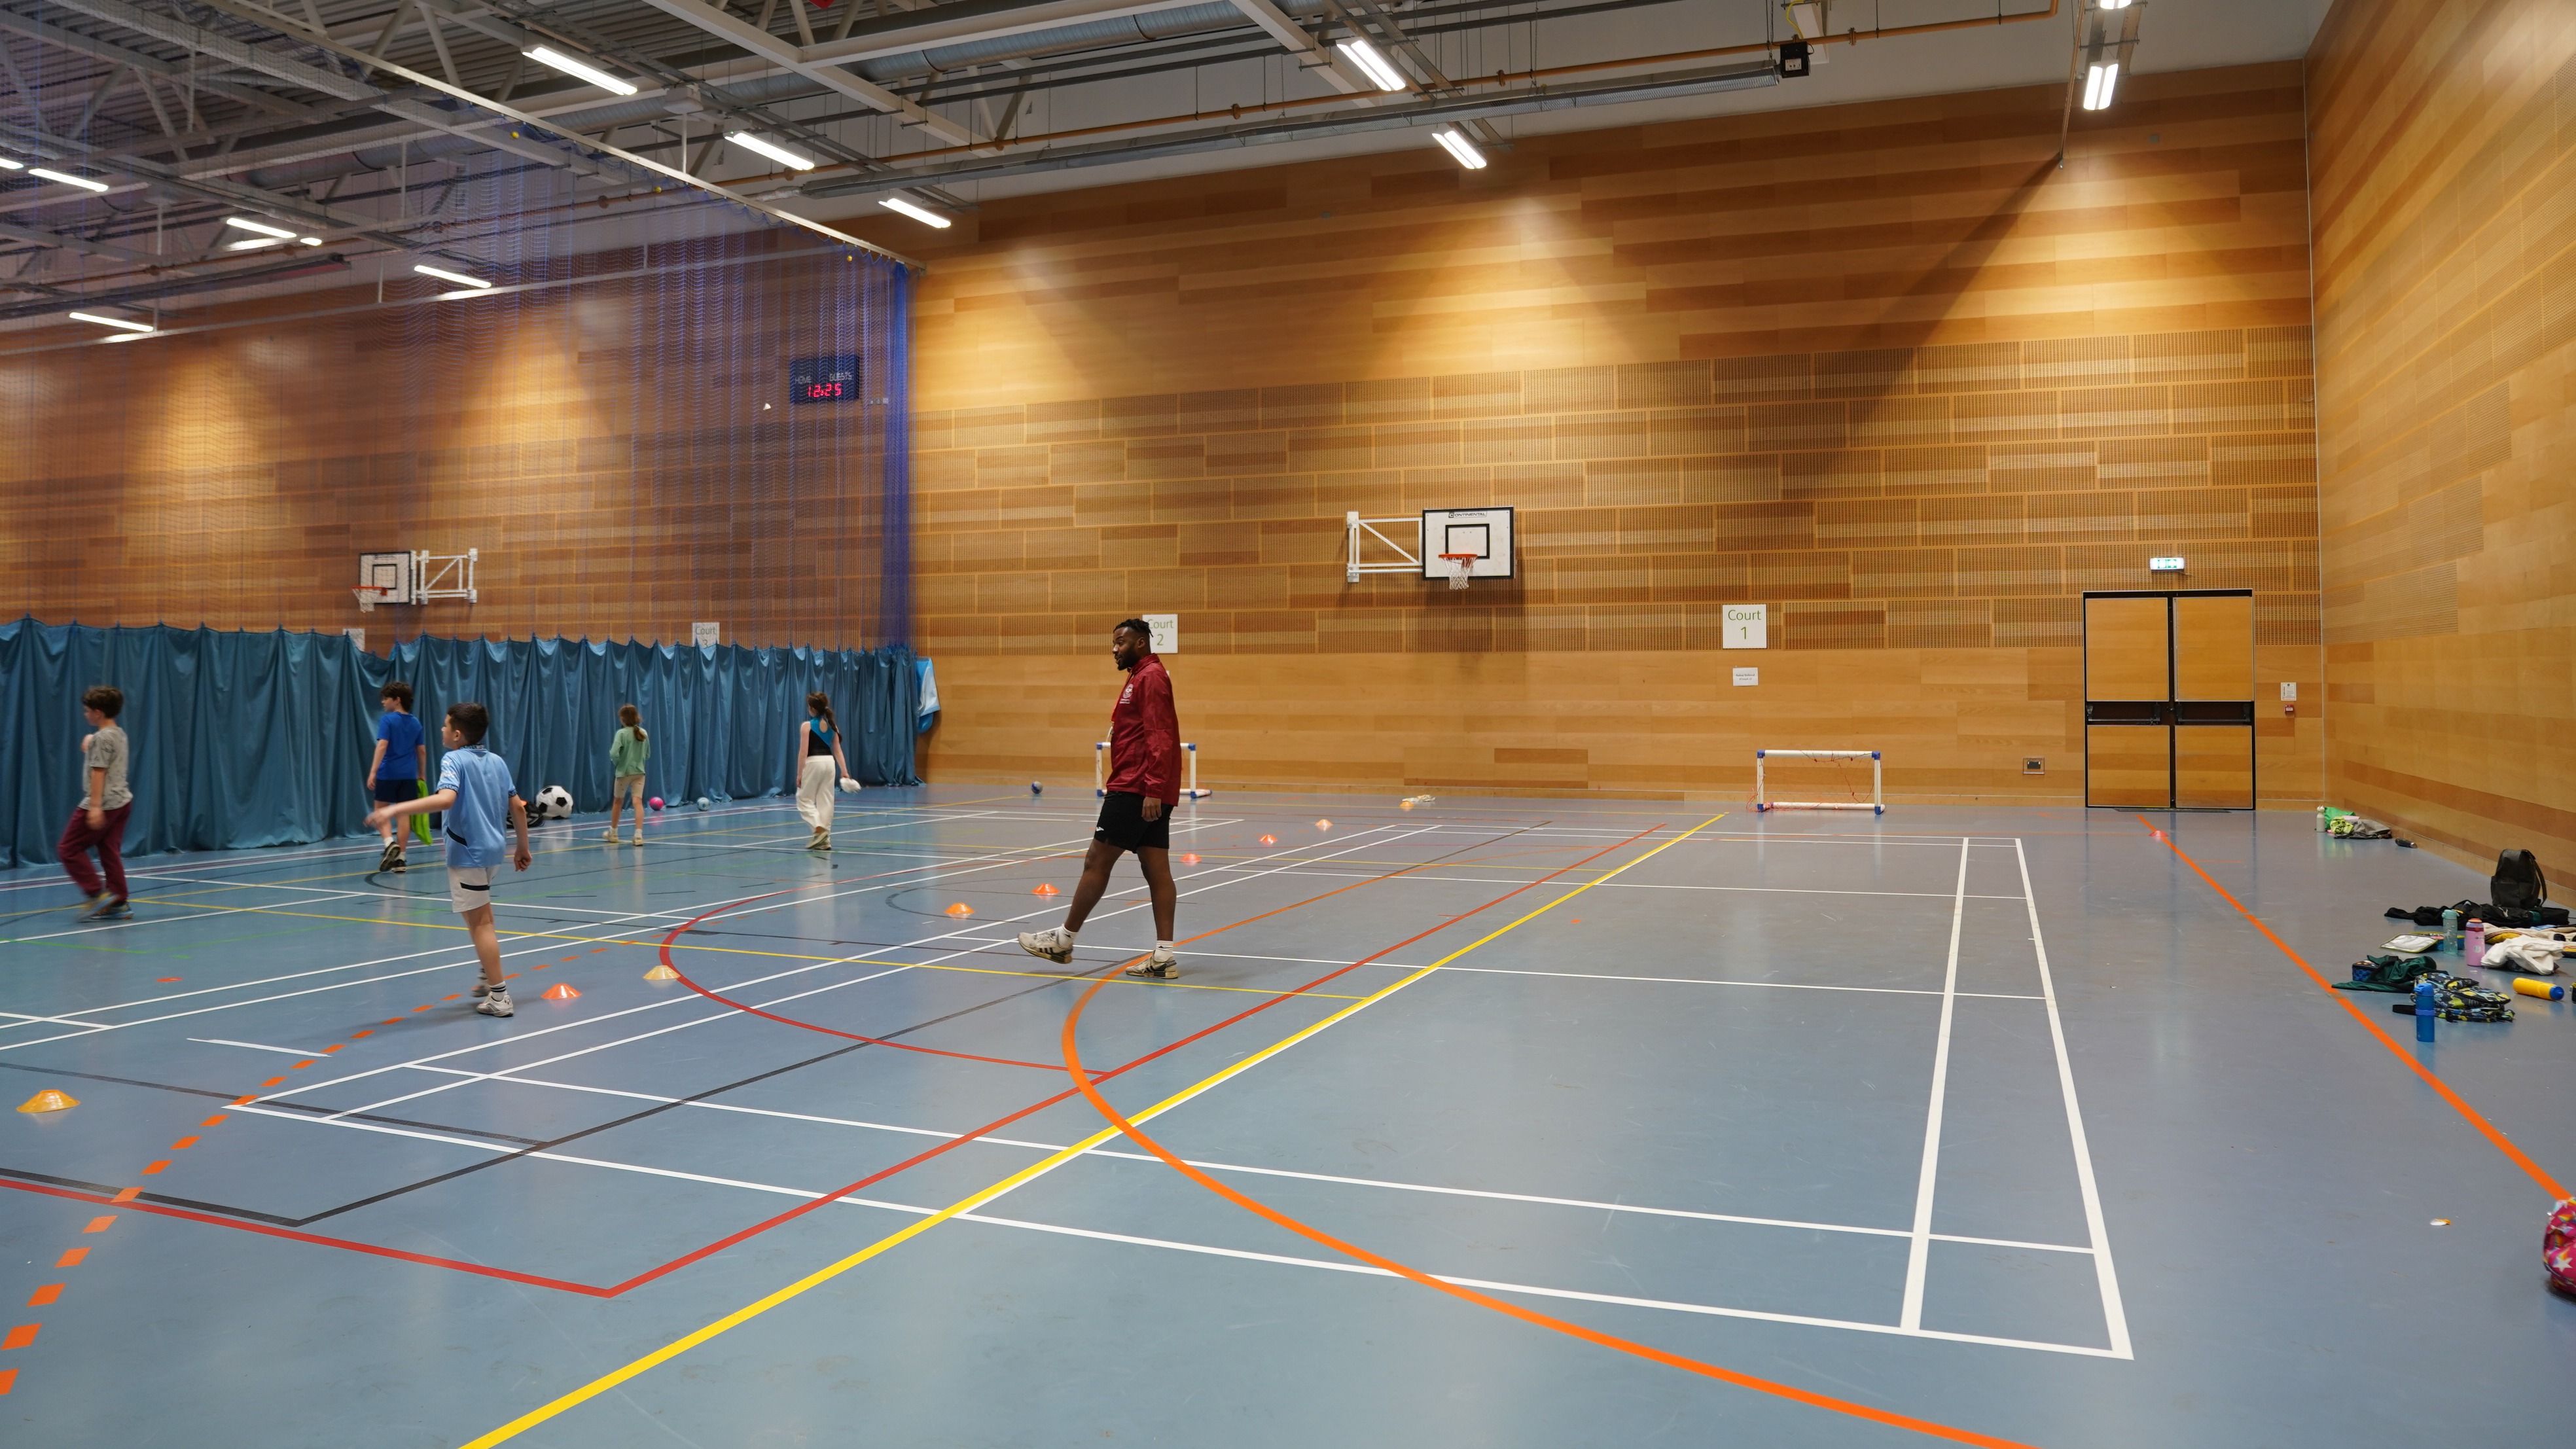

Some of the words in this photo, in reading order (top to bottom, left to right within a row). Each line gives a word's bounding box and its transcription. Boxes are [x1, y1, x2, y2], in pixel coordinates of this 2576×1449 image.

[808, 383, 842, 397] 12:25
[1728, 609, 1761, 621] Court
[1147, 619, 1174, 629] Court
[695, 626, 717, 635] Court
[1741, 626, 1746, 639] 1
[1156, 634, 1164, 646] 2
